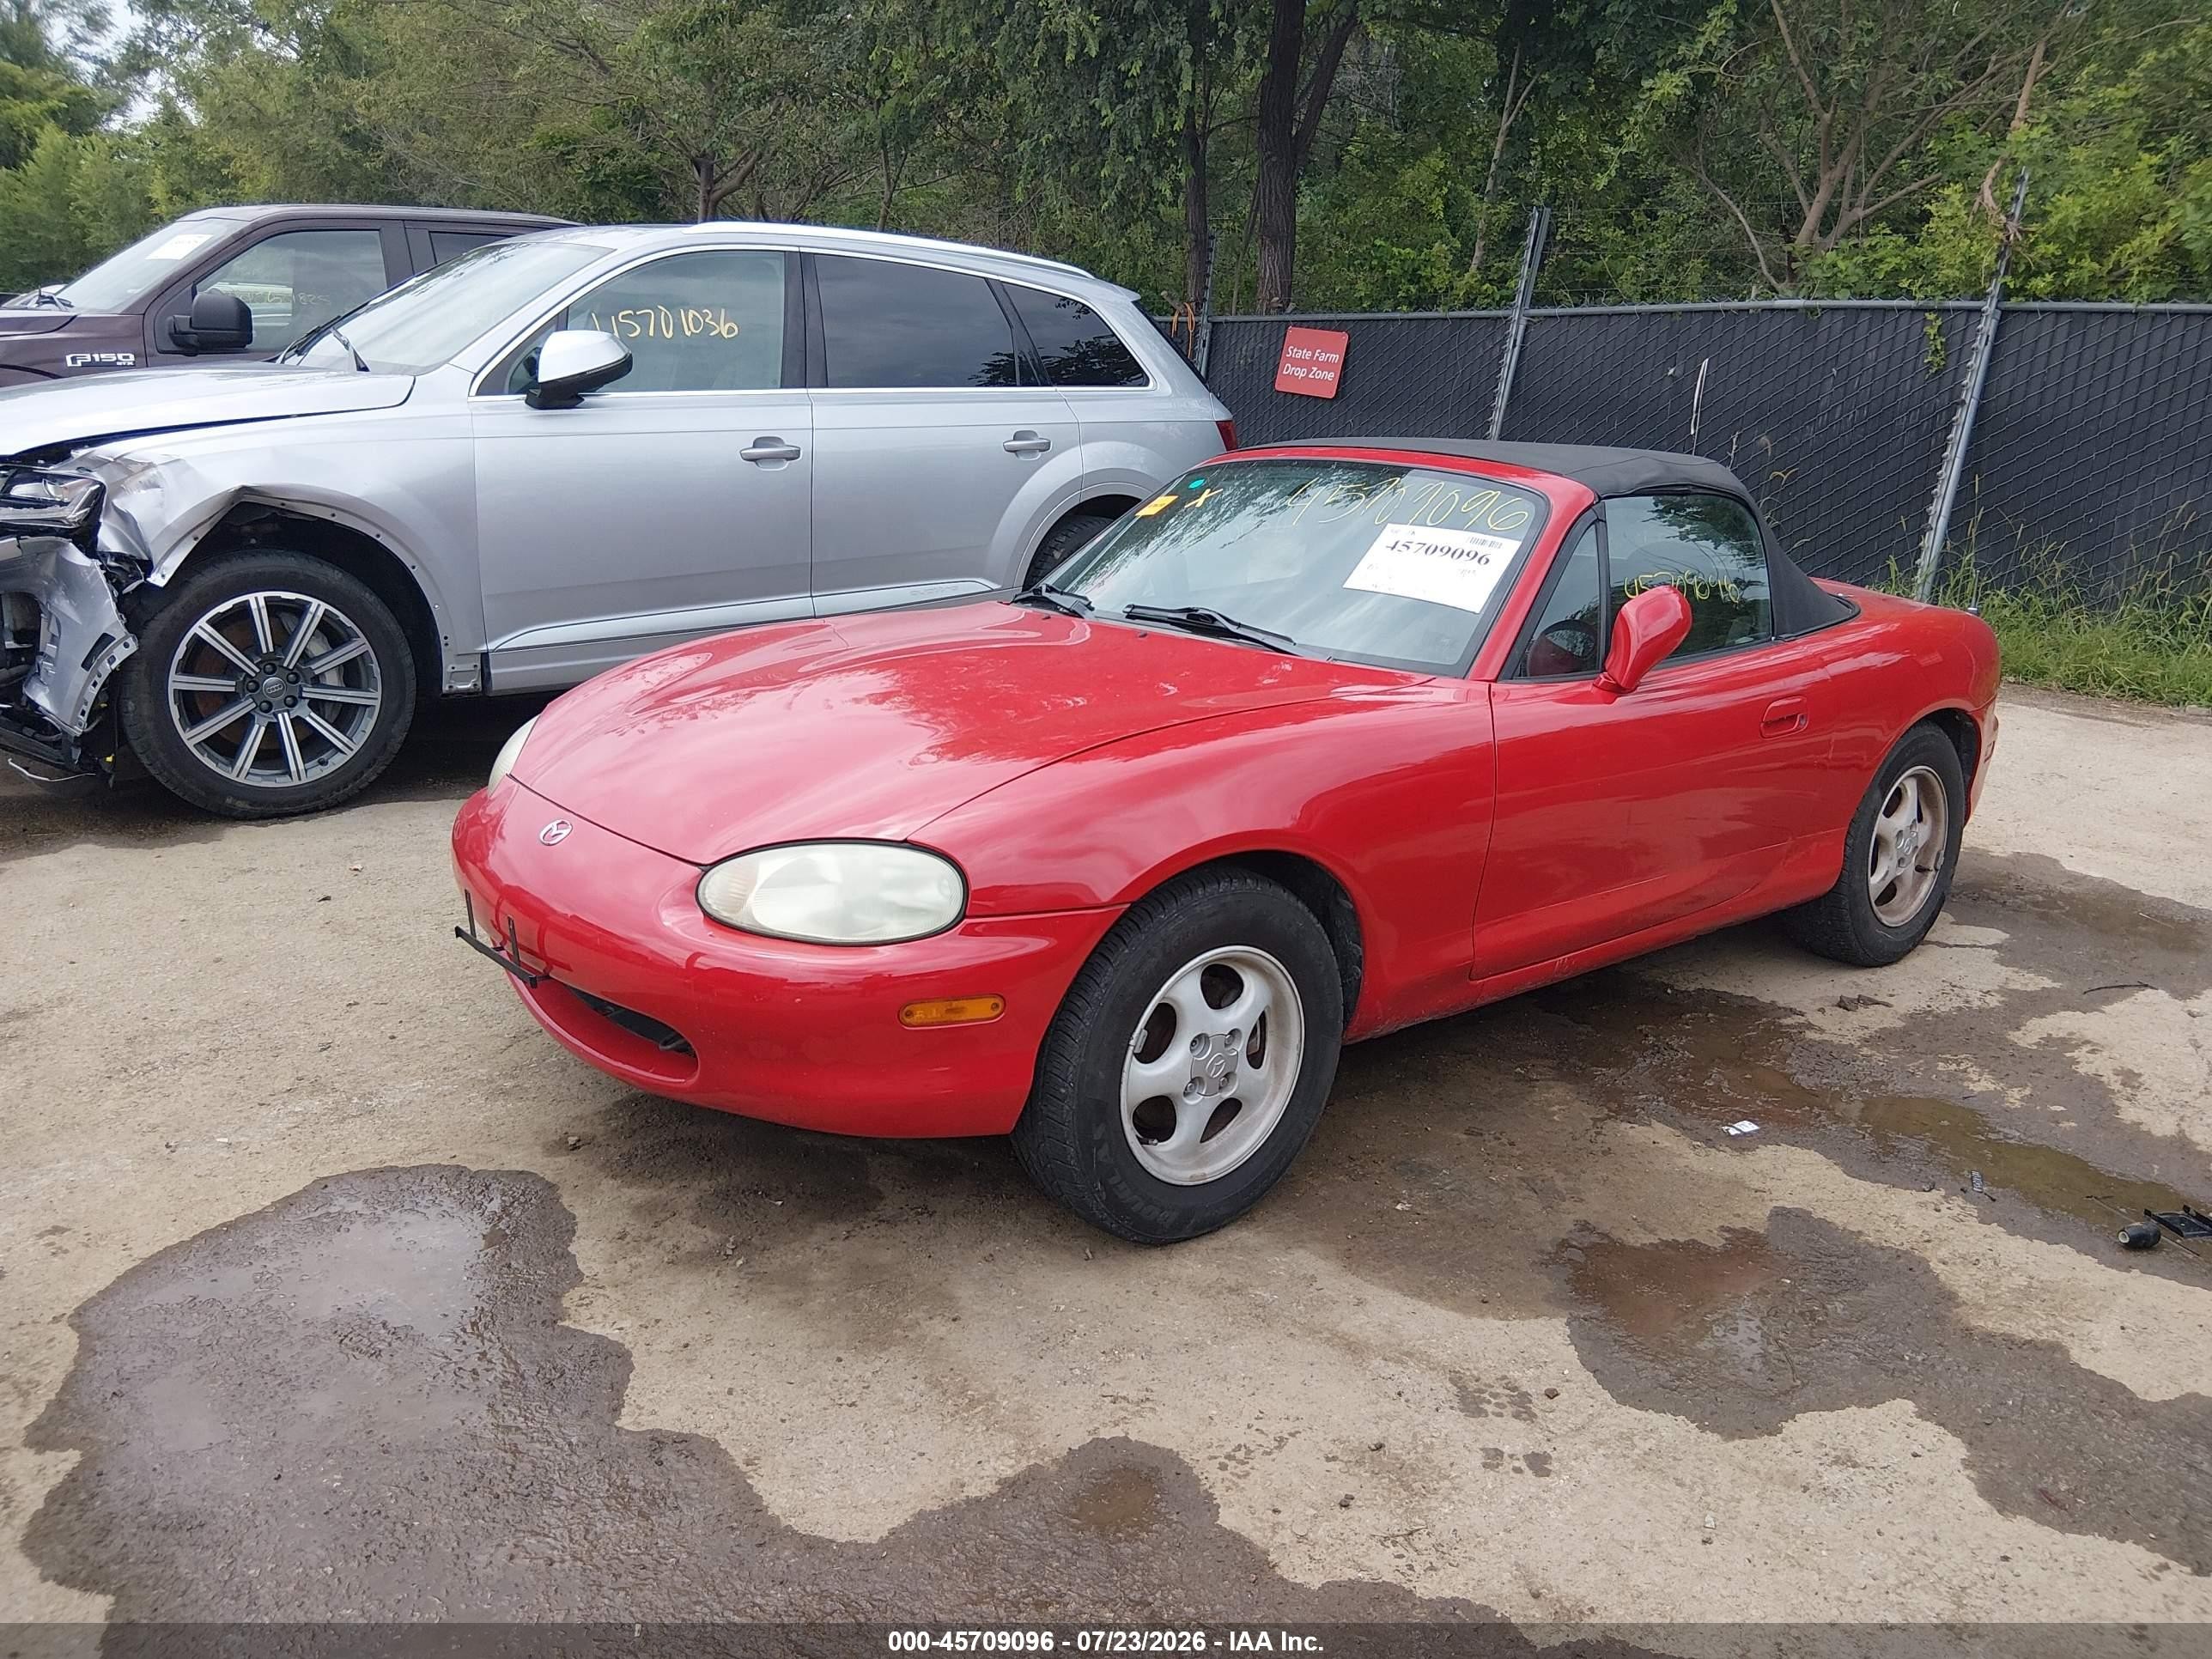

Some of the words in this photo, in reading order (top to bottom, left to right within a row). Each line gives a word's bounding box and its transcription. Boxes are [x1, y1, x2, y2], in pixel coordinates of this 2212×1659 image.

[1285, 346, 1312, 360] State
[1313, 349, 1340, 363] Farm
[1283, 363, 1307, 380] Drop
[1308, 367, 1335, 381] Zone
[1385, 539, 1492, 567] 45709096
